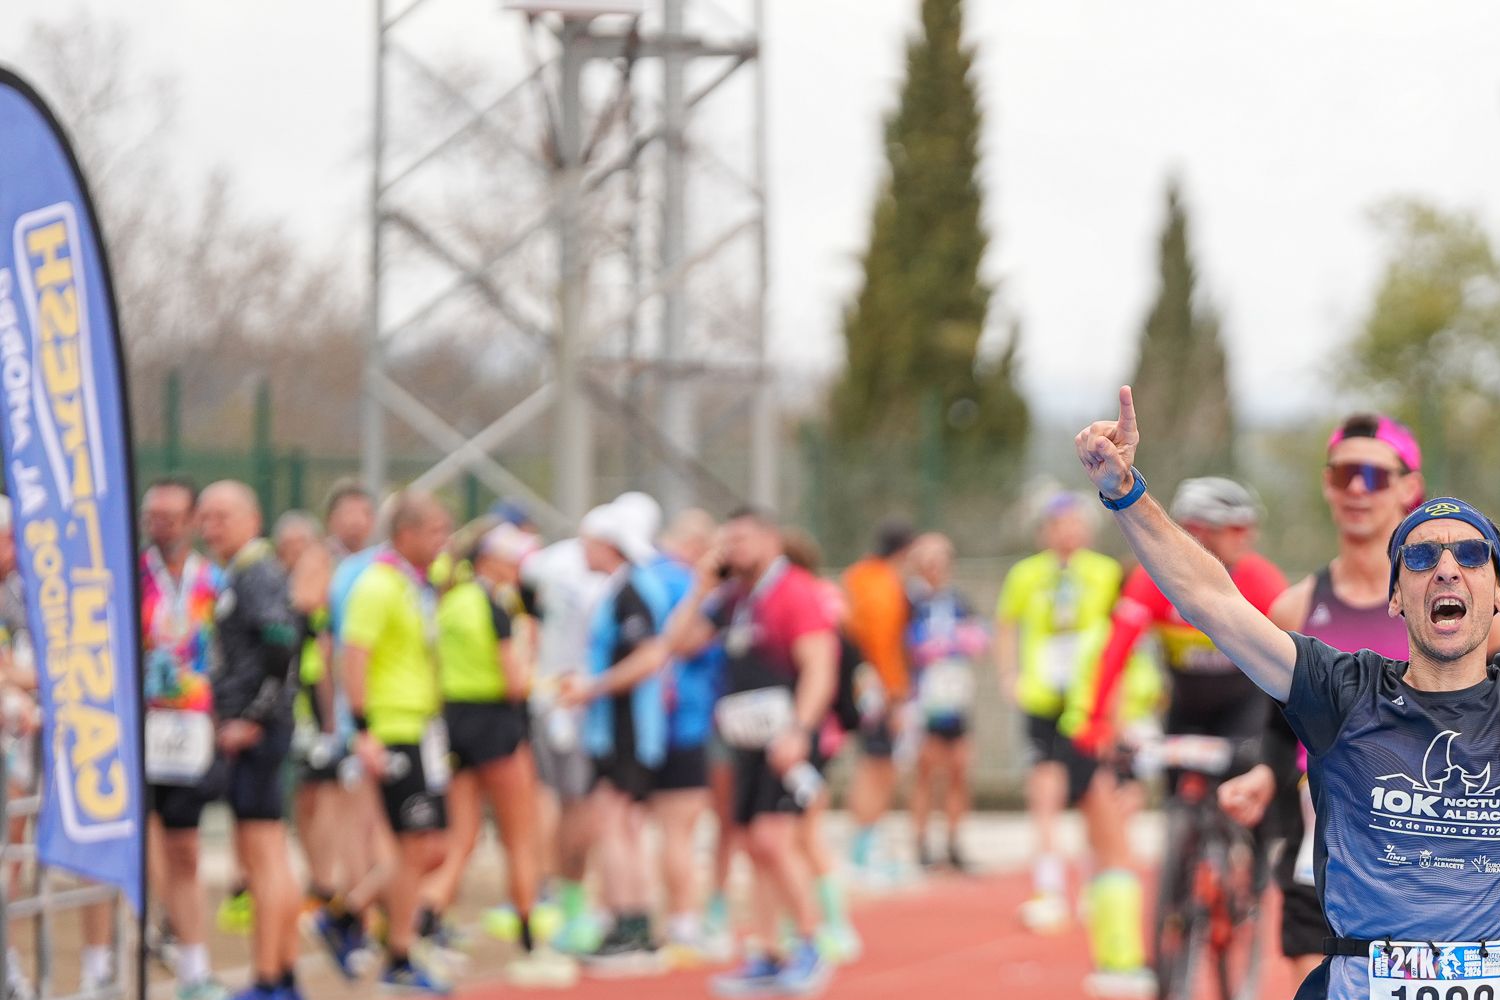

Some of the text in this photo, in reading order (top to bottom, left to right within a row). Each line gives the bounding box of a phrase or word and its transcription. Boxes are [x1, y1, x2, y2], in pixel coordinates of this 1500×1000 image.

[1371, 786, 1442, 818] 10K
[1389, 820, 1403, 828] 04
[1405, 822, 1420, 830] de
[1425, 825, 1457, 834] mayo
[1462, 827, 1477, 835] de
[1391, 946, 1437, 979] 21K
